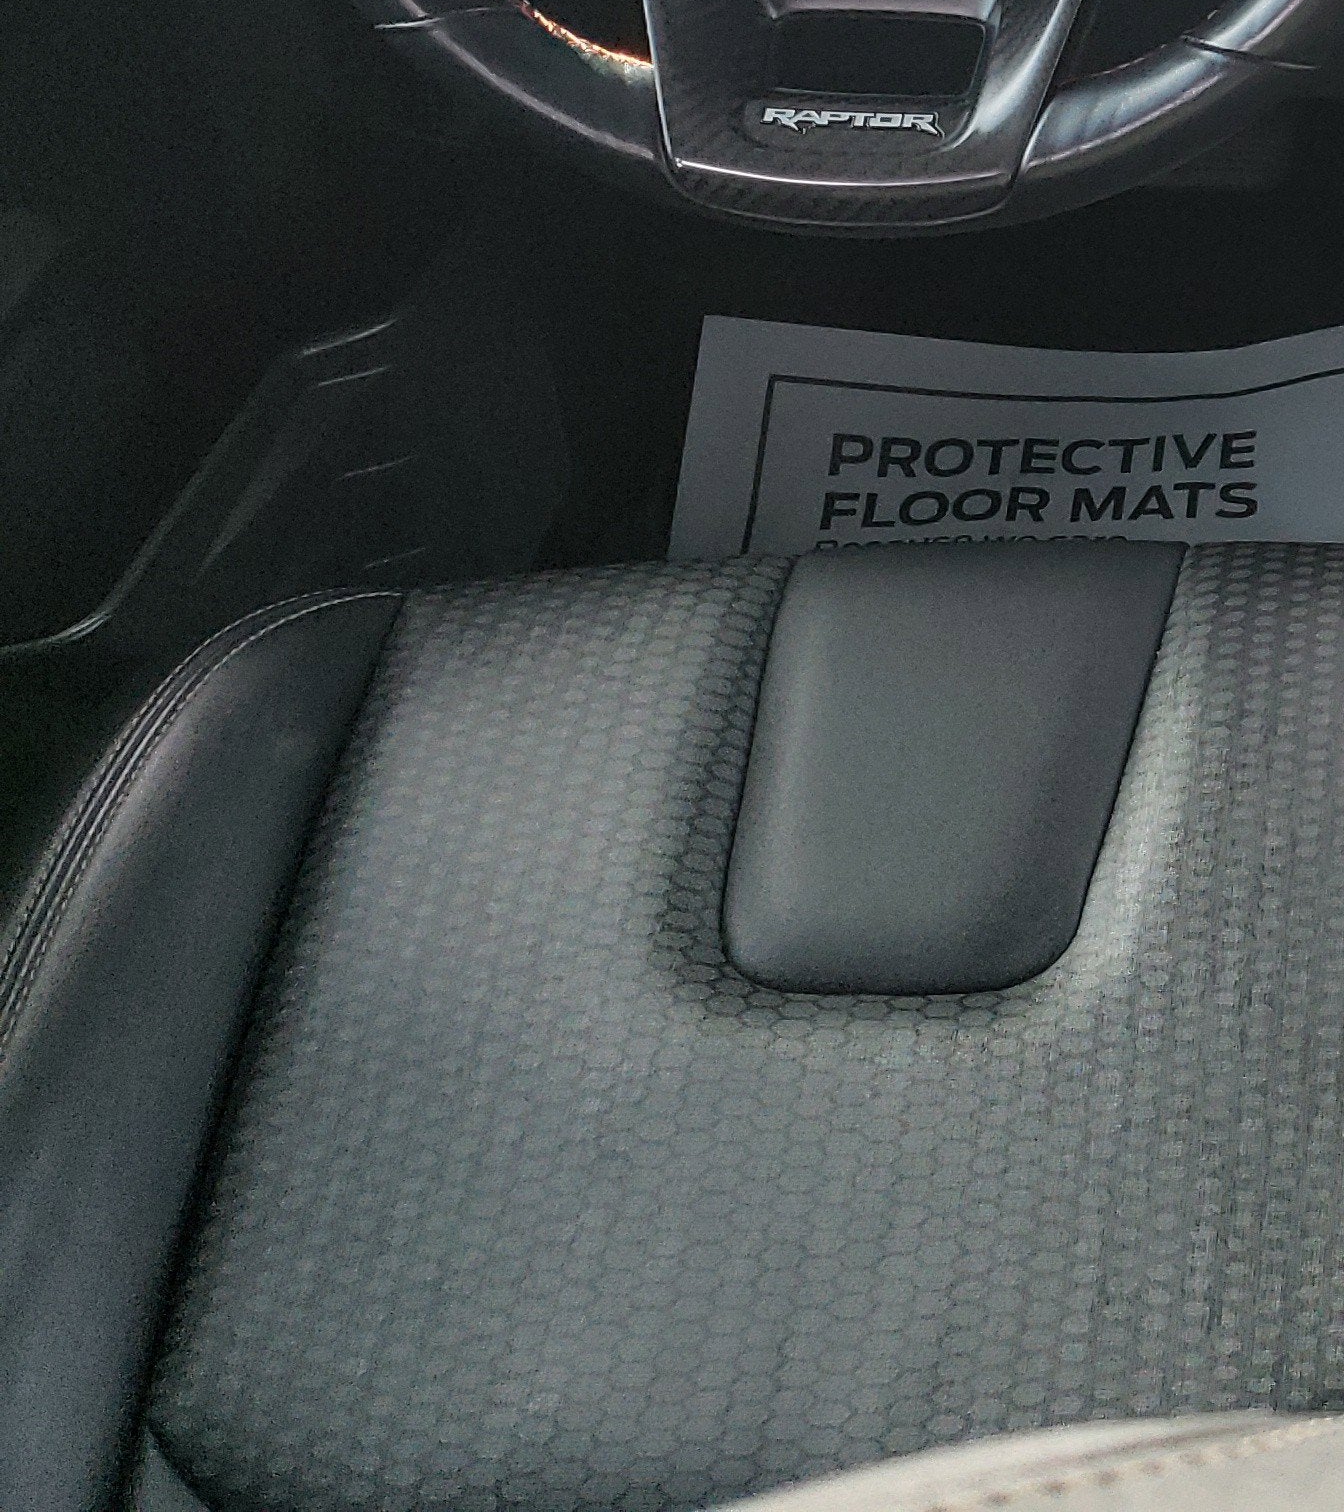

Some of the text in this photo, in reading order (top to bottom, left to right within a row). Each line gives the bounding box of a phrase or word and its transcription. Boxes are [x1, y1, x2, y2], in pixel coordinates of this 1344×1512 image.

[761, 107, 945, 138] RAPTOR
[828, 431, 1257, 478] PROTECTIVE
[820, 481, 1258, 530] FLOOR MATS
